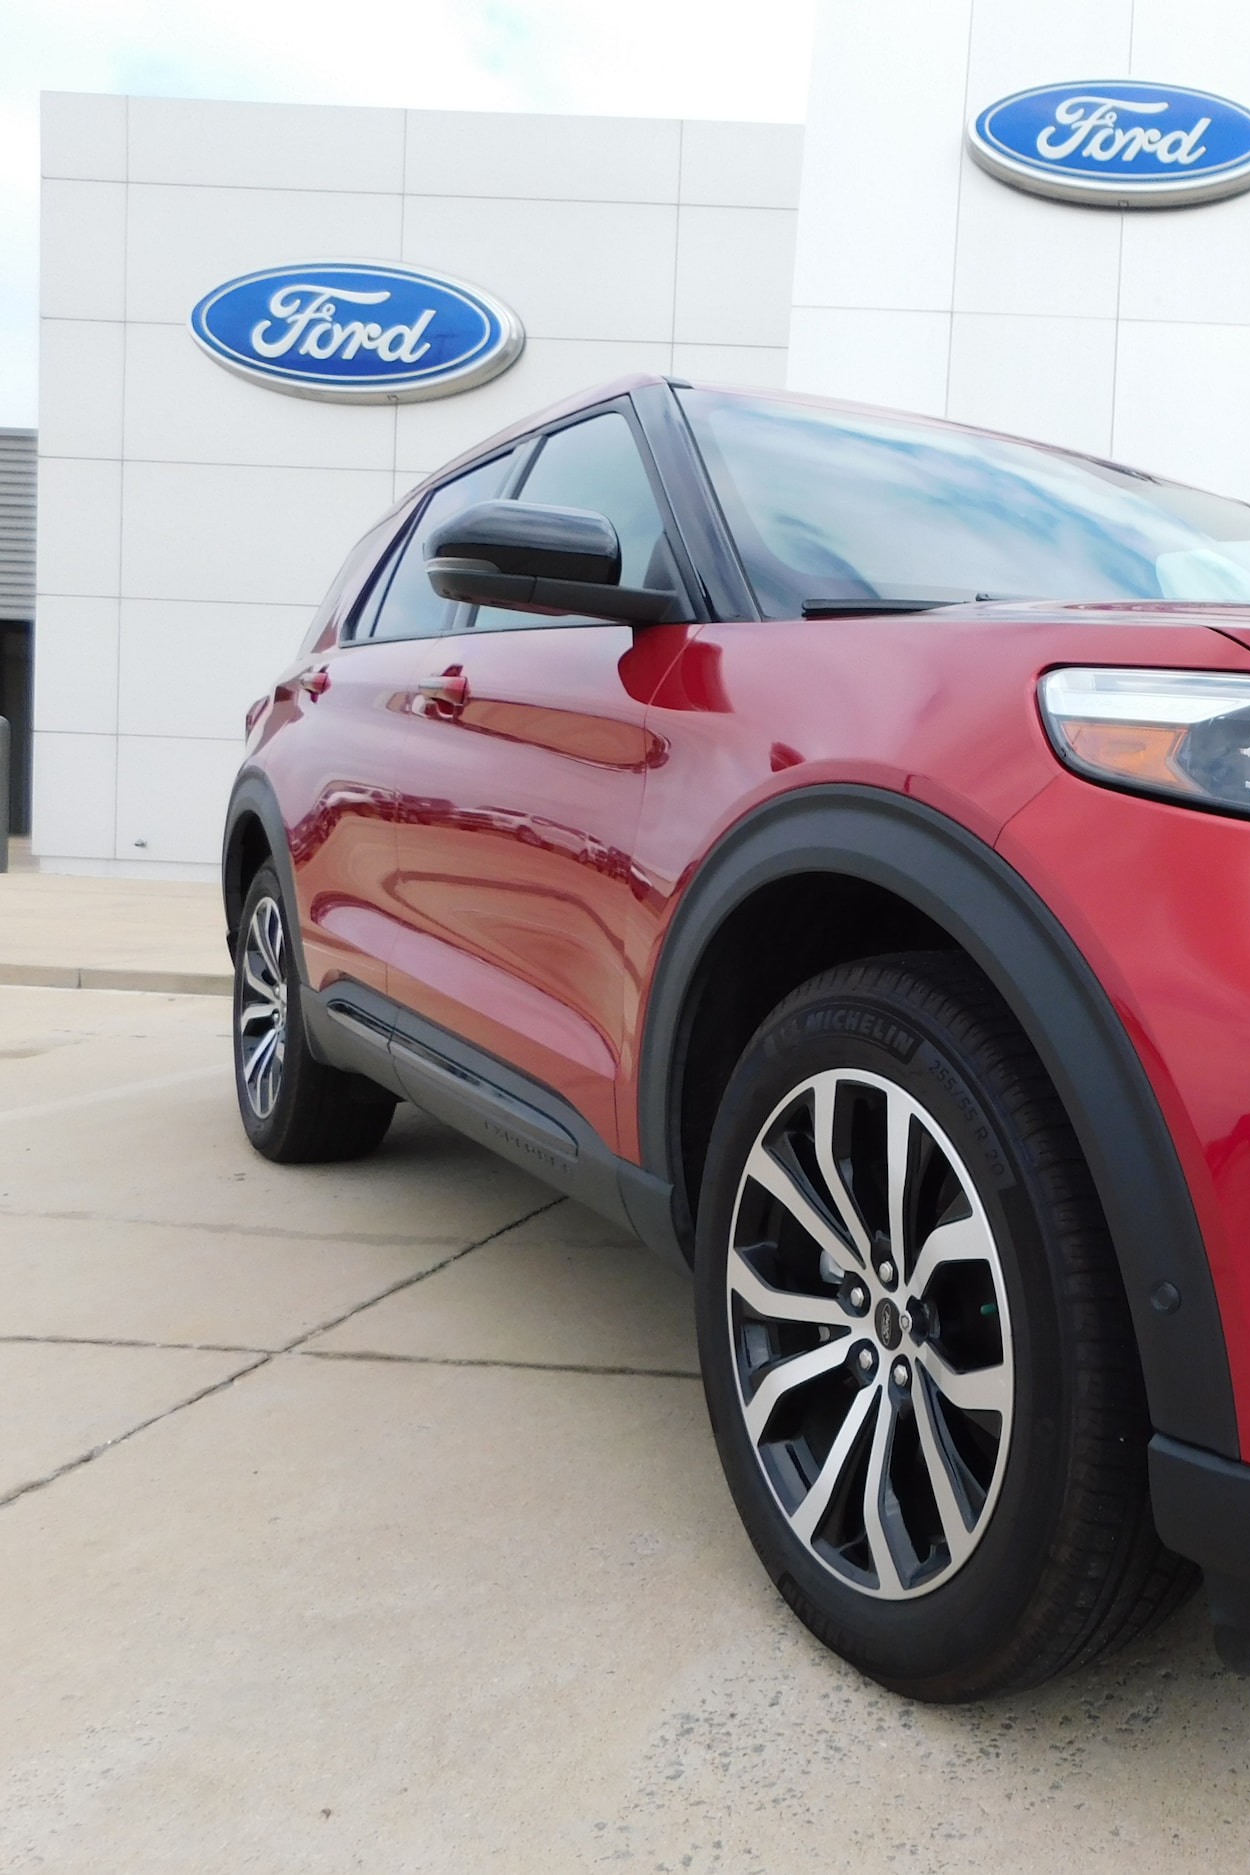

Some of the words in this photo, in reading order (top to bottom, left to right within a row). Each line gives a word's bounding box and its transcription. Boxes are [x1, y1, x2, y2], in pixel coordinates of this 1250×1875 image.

[1036, 95, 1212, 165] Ford
[251, 283, 437, 363] Ford
[805, 1008, 917, 1056] MICHELIN
[927, 1059, 978, 1122] 255/55
[973, 1127, 989, 1142] R
